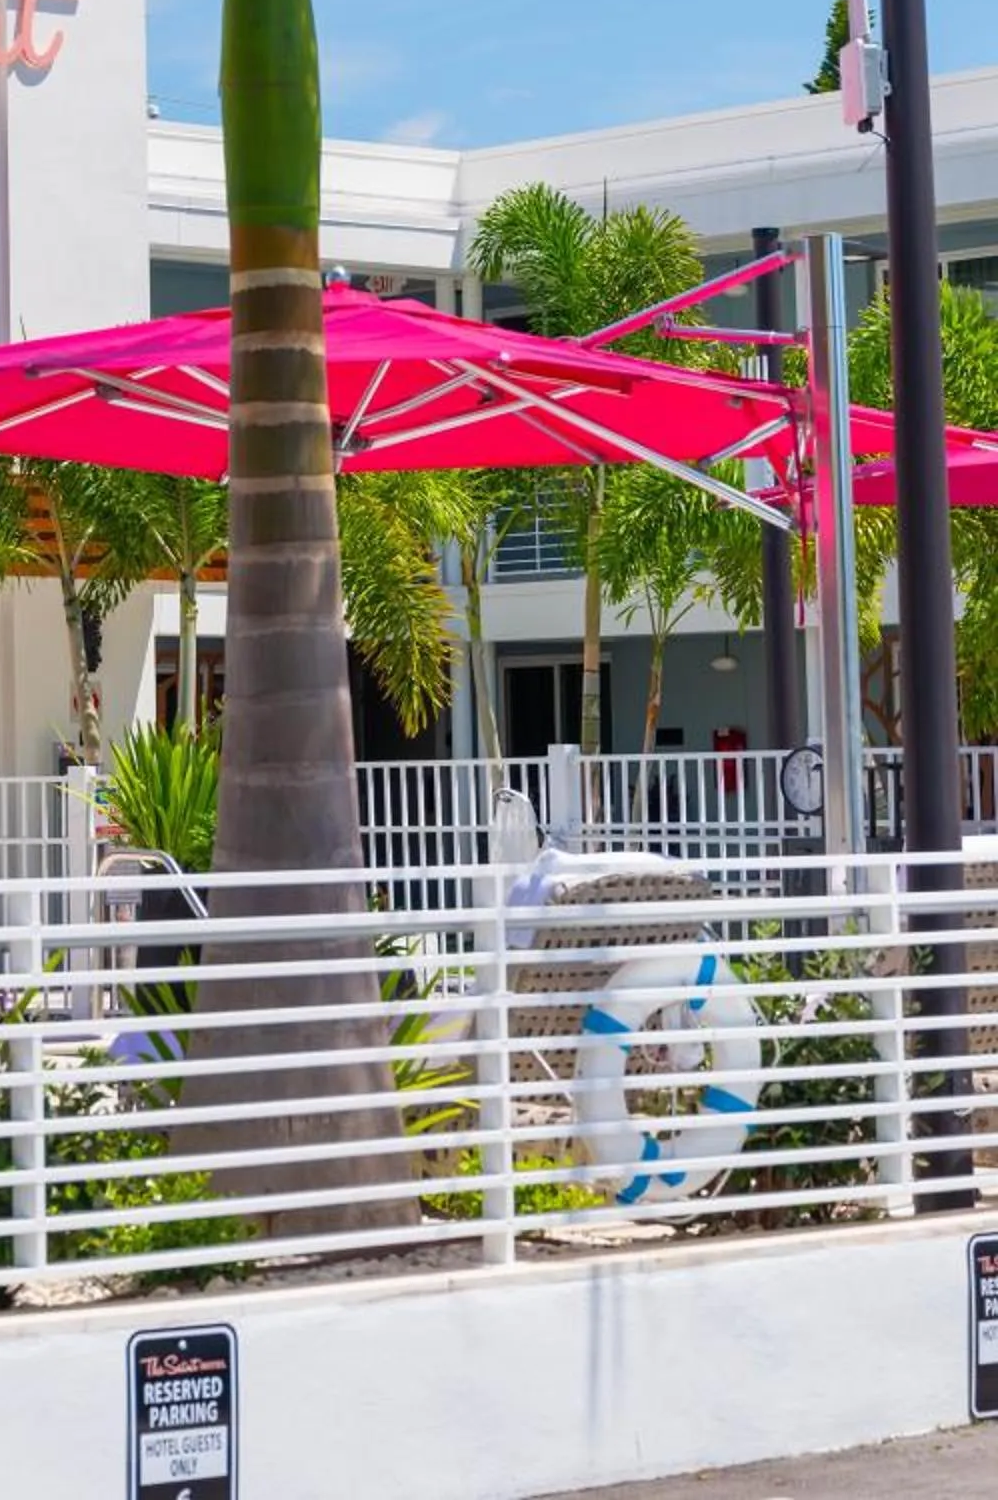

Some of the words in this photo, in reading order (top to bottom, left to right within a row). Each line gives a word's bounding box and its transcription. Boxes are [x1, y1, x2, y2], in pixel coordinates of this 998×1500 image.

[143, 1376, 224, 1406] RESERVED
[149, 1401, 219, 1429] PARKING
[145, 1439, 180, 1459] HOTEL
[181, 1432, 222, 1454] GUESTS
[169, 1457, 199, 1477] ONLY
